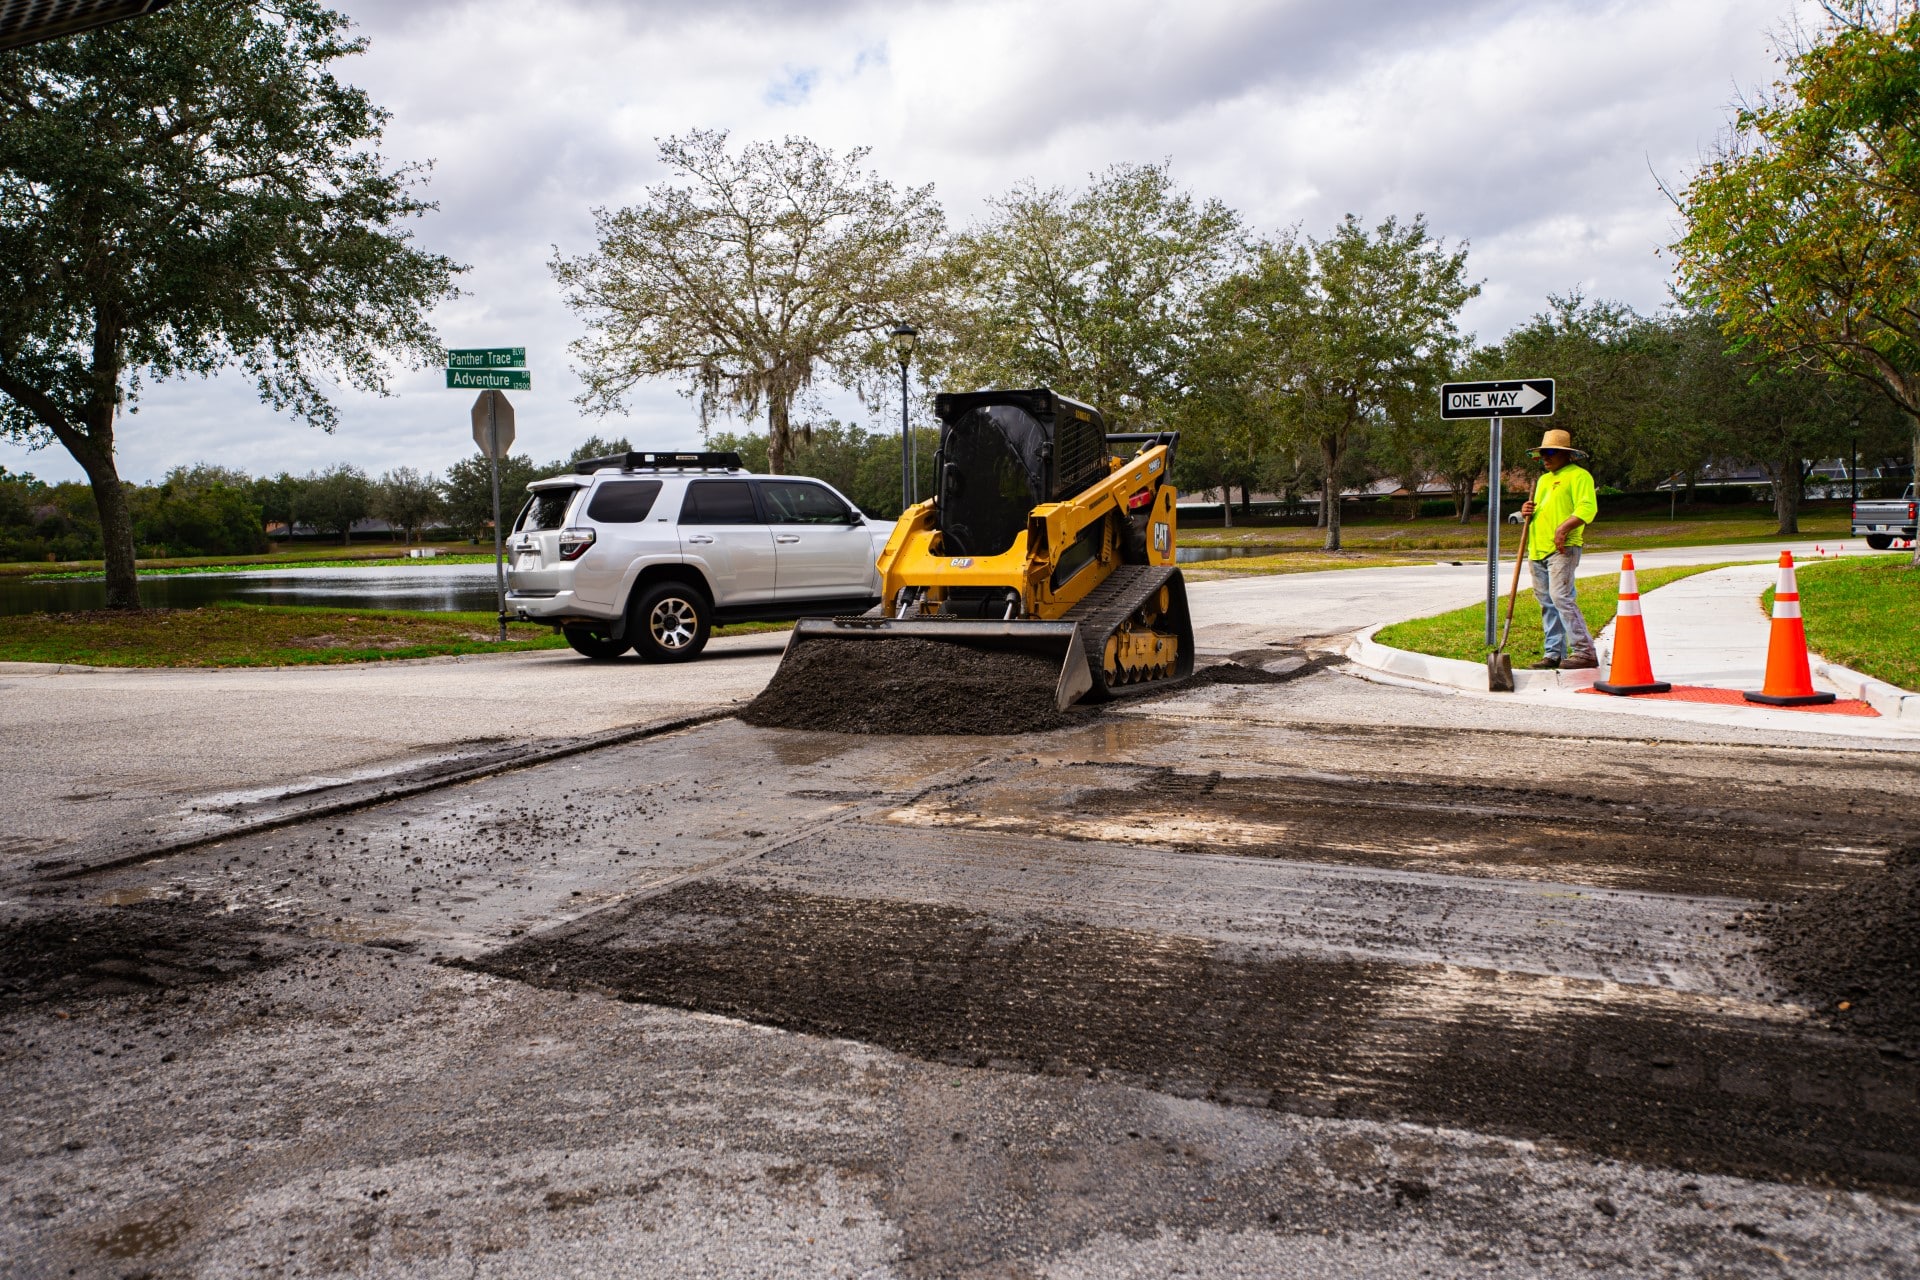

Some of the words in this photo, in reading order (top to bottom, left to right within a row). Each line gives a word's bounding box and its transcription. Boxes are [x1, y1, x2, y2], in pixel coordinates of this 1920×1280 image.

[450, 352, 483, 366] Panther
[487, 351, 511, 365] Trace
[453, 372, 510, 386] Adventure
[512, 382, 531, 390] 12500
[1452, 394, 1482, 408] ONE
[1487, 392, 1518, 406] WAY
[1154, 522, 1168, 551] CAT
[950, 558, 970, 567] CAT
